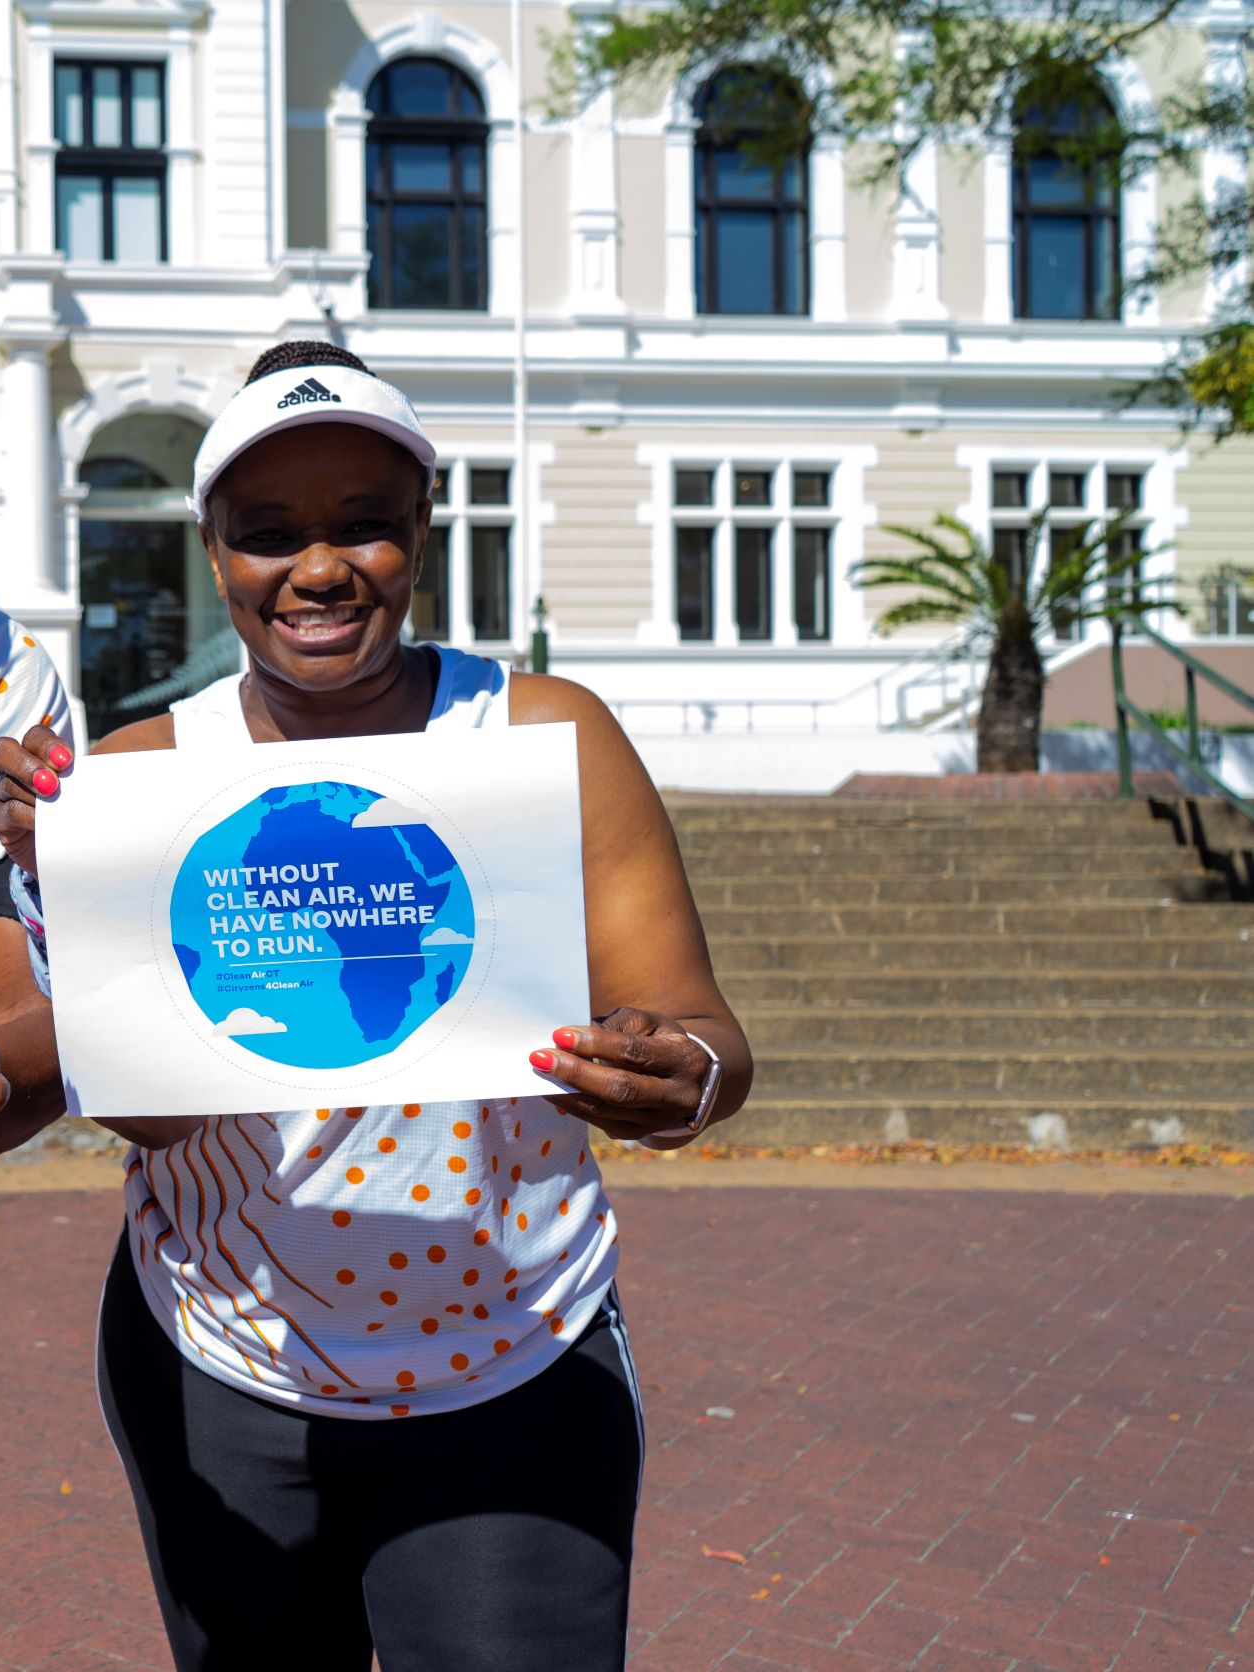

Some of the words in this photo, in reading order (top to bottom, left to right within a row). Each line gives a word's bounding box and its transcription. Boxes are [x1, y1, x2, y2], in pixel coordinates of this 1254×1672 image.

[203, 862, 339, 887] WITHOUT
[206, 888, 301, 911] CLEAN
[307, 886, 364, 906] AIR,
[369, 882, 415, 902] WE
[209, 912, 285, 934] HAVE
[291, 905, 436, 930] NOWHERE
[211, 938, 251, 958] TO
[257, 935, 323, 956] RUN.
[216, 969, 280, 980] #CleanAirCT
[217, 980, 314, 993] #Cityzens4CleanAir
